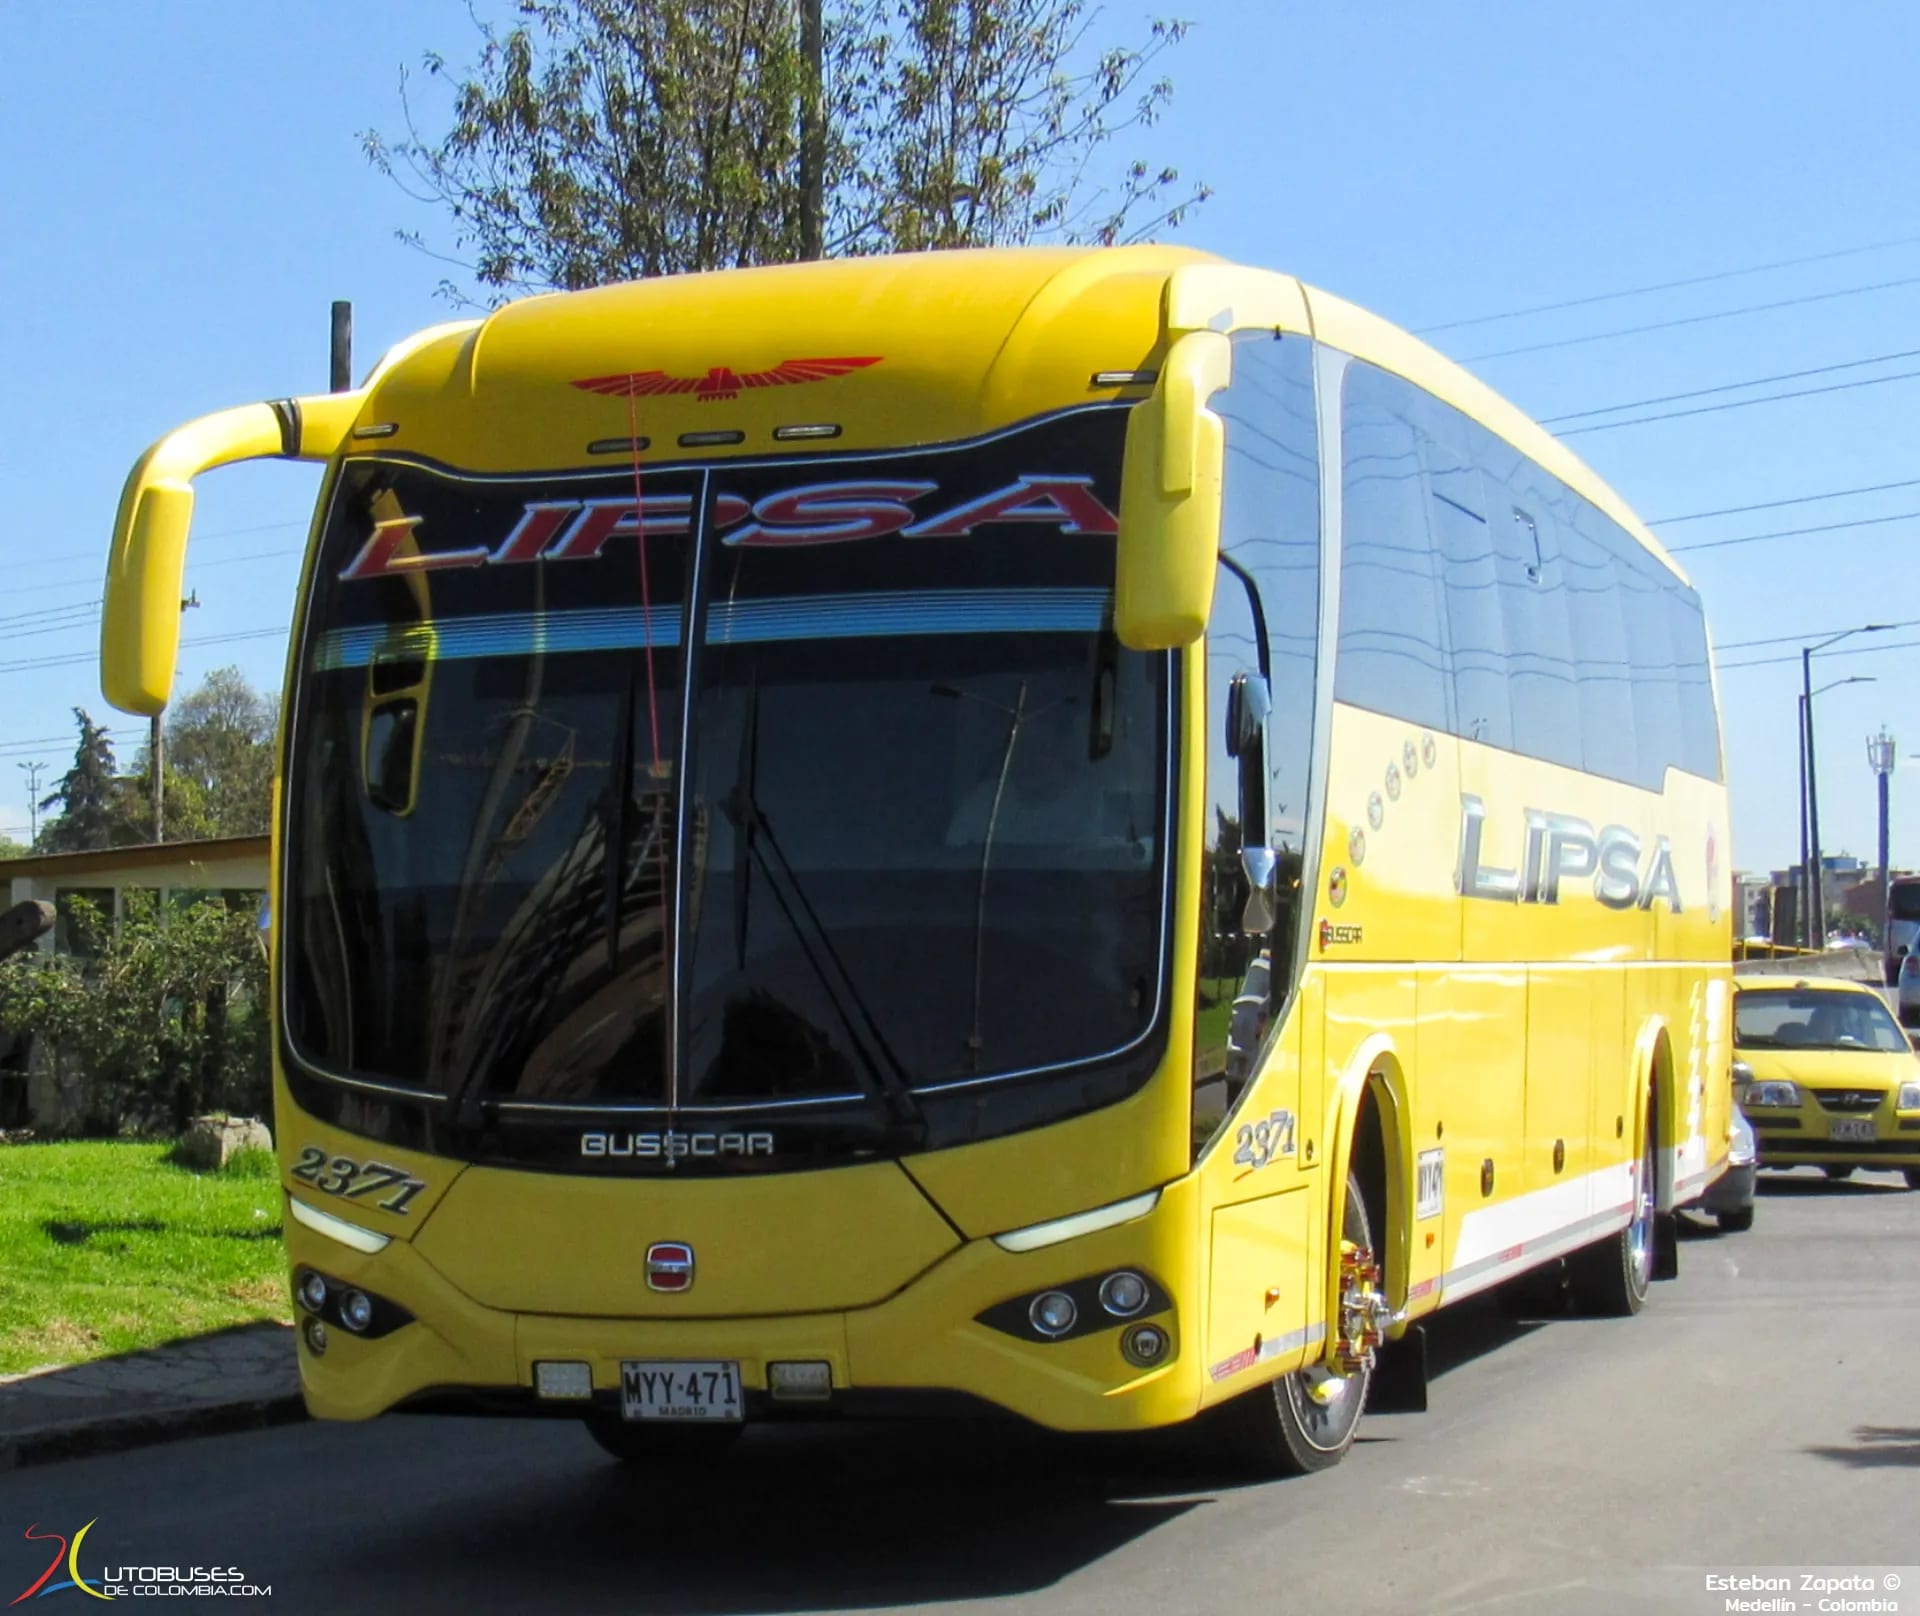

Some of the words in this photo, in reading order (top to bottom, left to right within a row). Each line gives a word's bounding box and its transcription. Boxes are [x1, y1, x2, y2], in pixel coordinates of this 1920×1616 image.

[337, 474, 1120, 581] LIPSA
[1454, 793, 1682, 914] LIPSA
[580, 1133, 775, 1156] BUSSCAR
[1234, 1109, 1296, 1168] 2371
[290, 1146, 427, 1215] 2371
